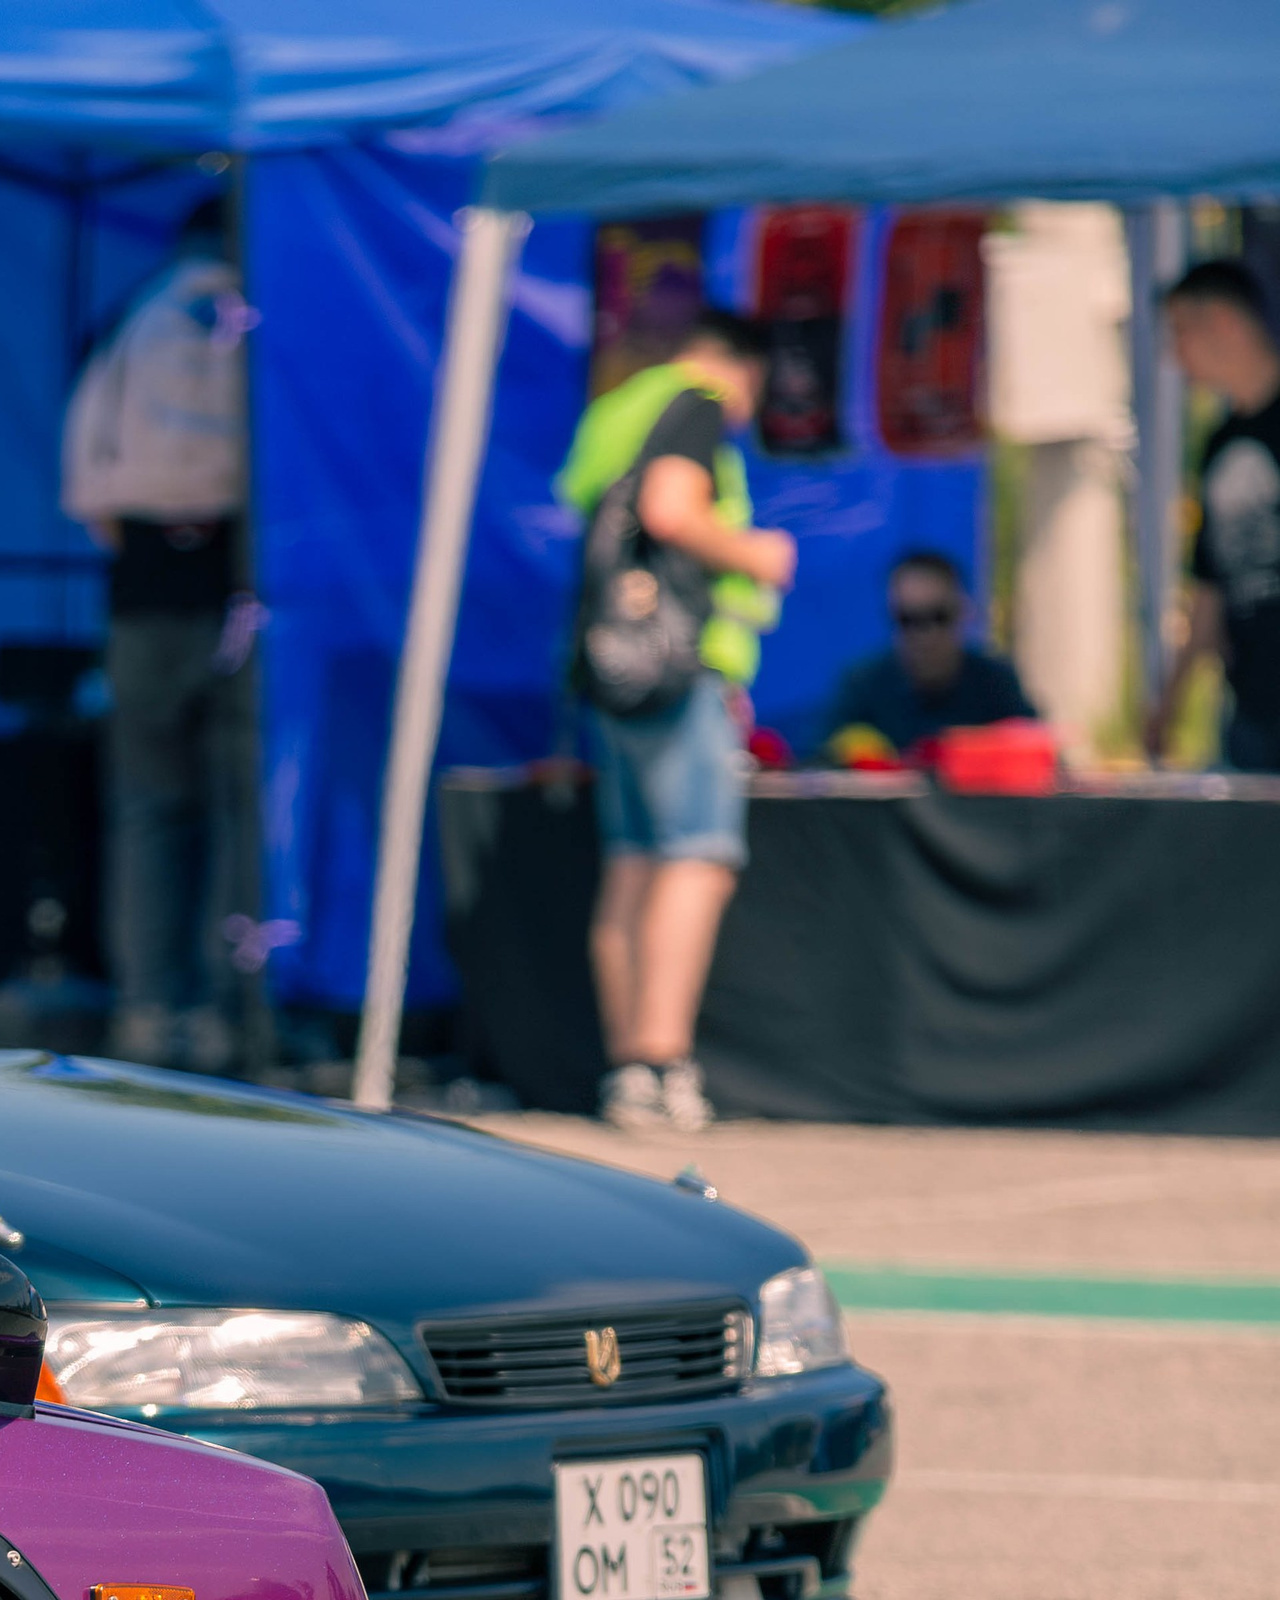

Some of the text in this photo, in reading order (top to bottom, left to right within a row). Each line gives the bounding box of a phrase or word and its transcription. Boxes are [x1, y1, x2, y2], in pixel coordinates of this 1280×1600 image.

[583, 1468, 680, 1526] X 090
[573, 1533, 695, 1595] OM 52
